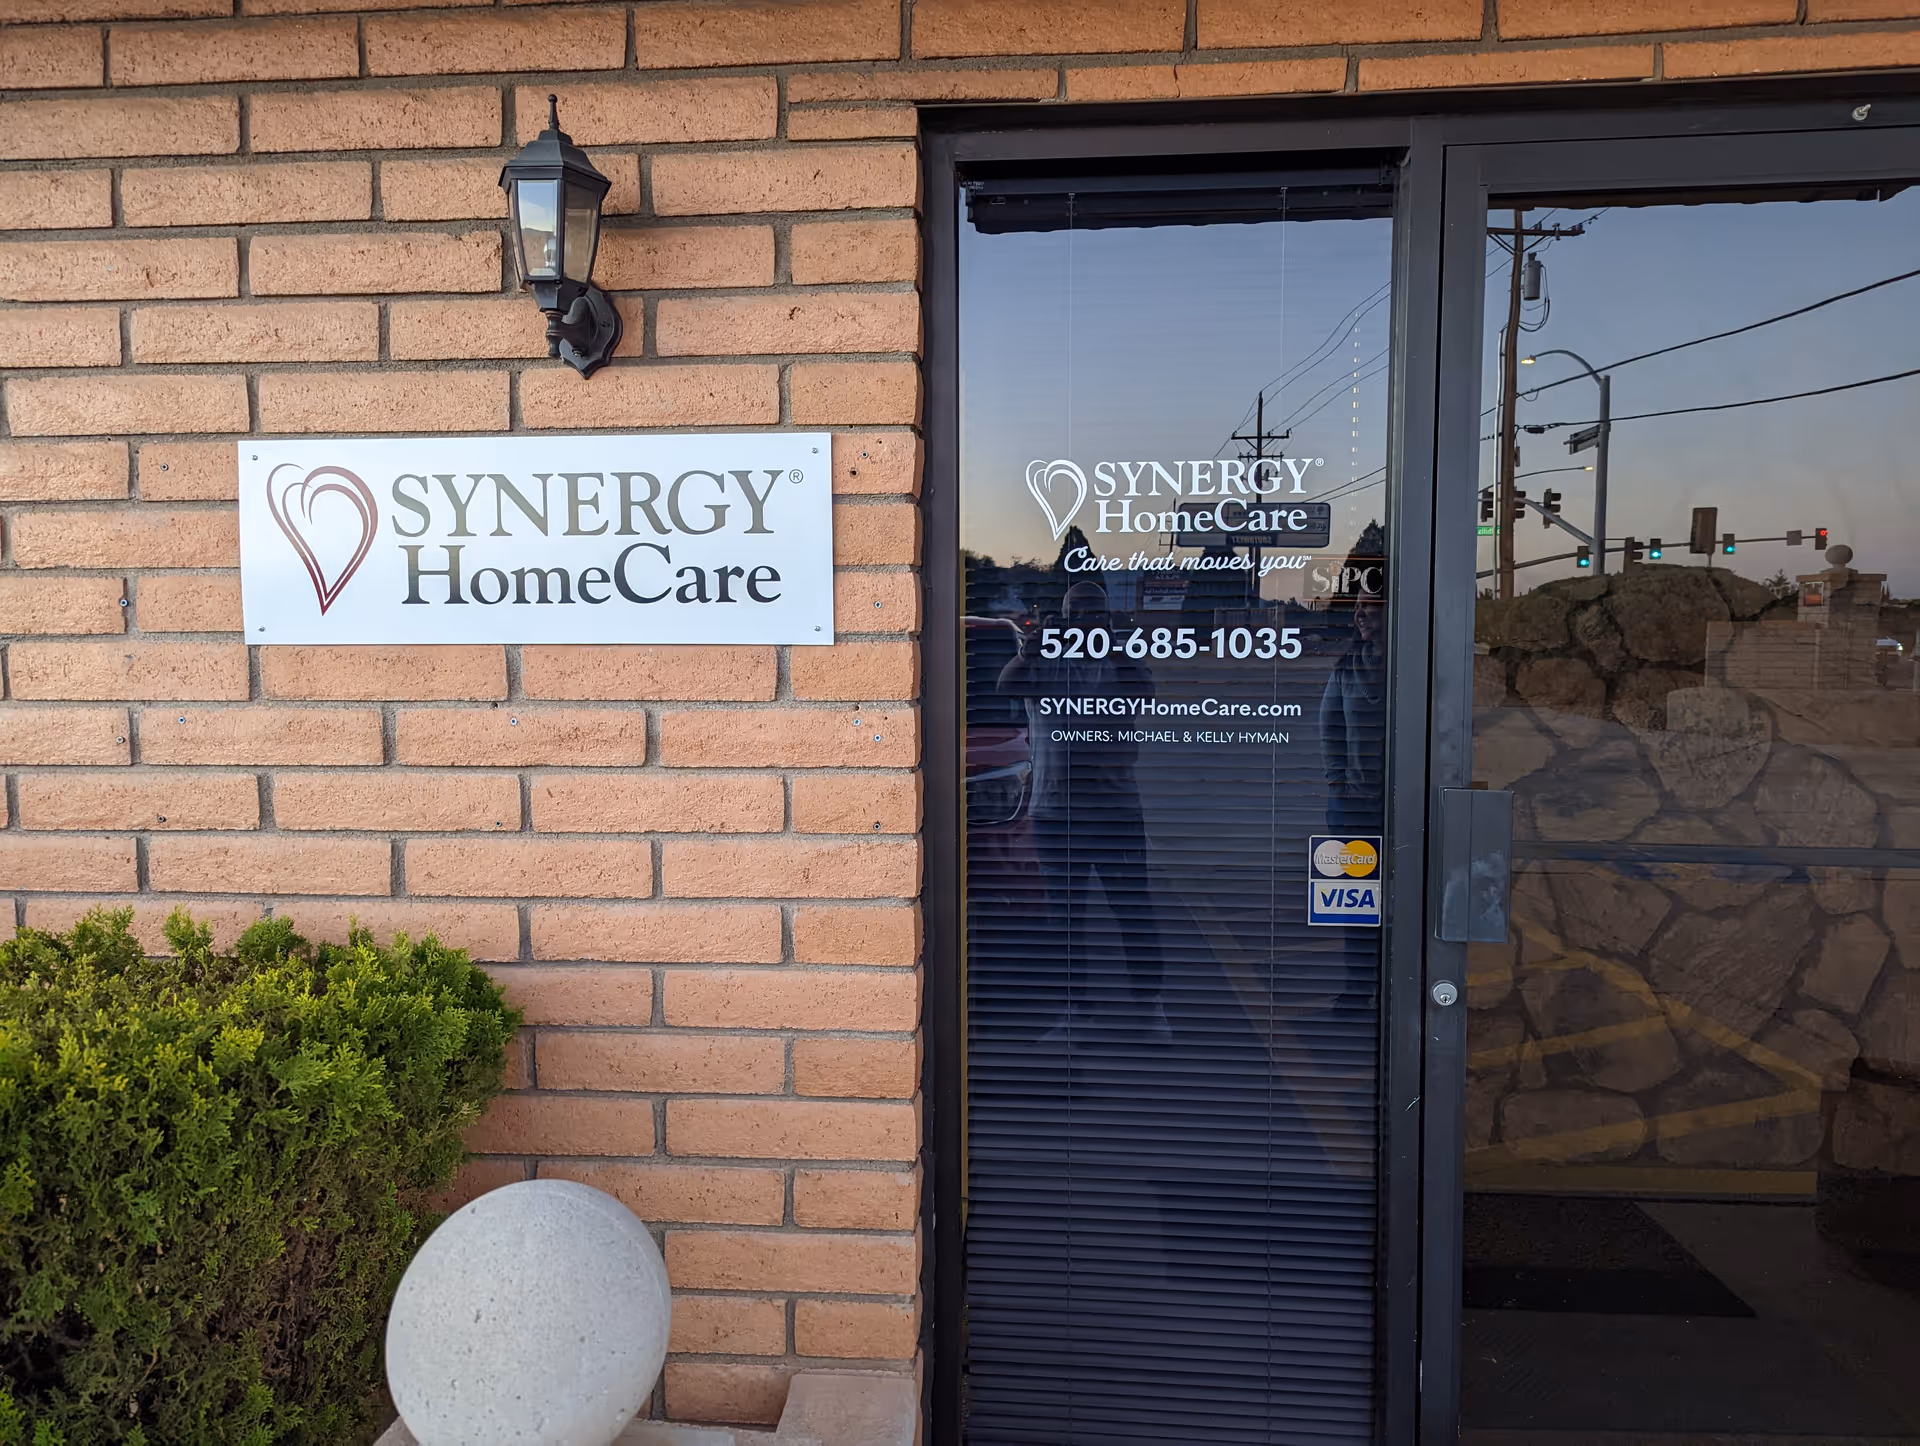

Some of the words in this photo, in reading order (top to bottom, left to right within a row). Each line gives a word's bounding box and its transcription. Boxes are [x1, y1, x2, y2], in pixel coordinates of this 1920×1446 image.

[1095, 497, 1308, 533] HomeCare
[1063, 545, 1123, 573] Care
[1128, 550, 1175, 571] that
[1179, 553, 1256, 571] moves
[398, 542, 782, 605] HomeCare
[1039, 627, 1303, 660] 520-685-1035
[1039, 697, 1302, 717] SYNERGYHomeCare.com
[1050, 730, 1113, 743] OWNERS:
[1117, 730, 1180, 743] MICHAEL
[1182, 731, 1193, 743] &
[1196, 731, 1235, 744] KELLY
[1238, 732, 1290, 744] HYMAN
[1315, 853, 1377, 865] MasterCard
[1320, 888, 1376, 909] VISA
